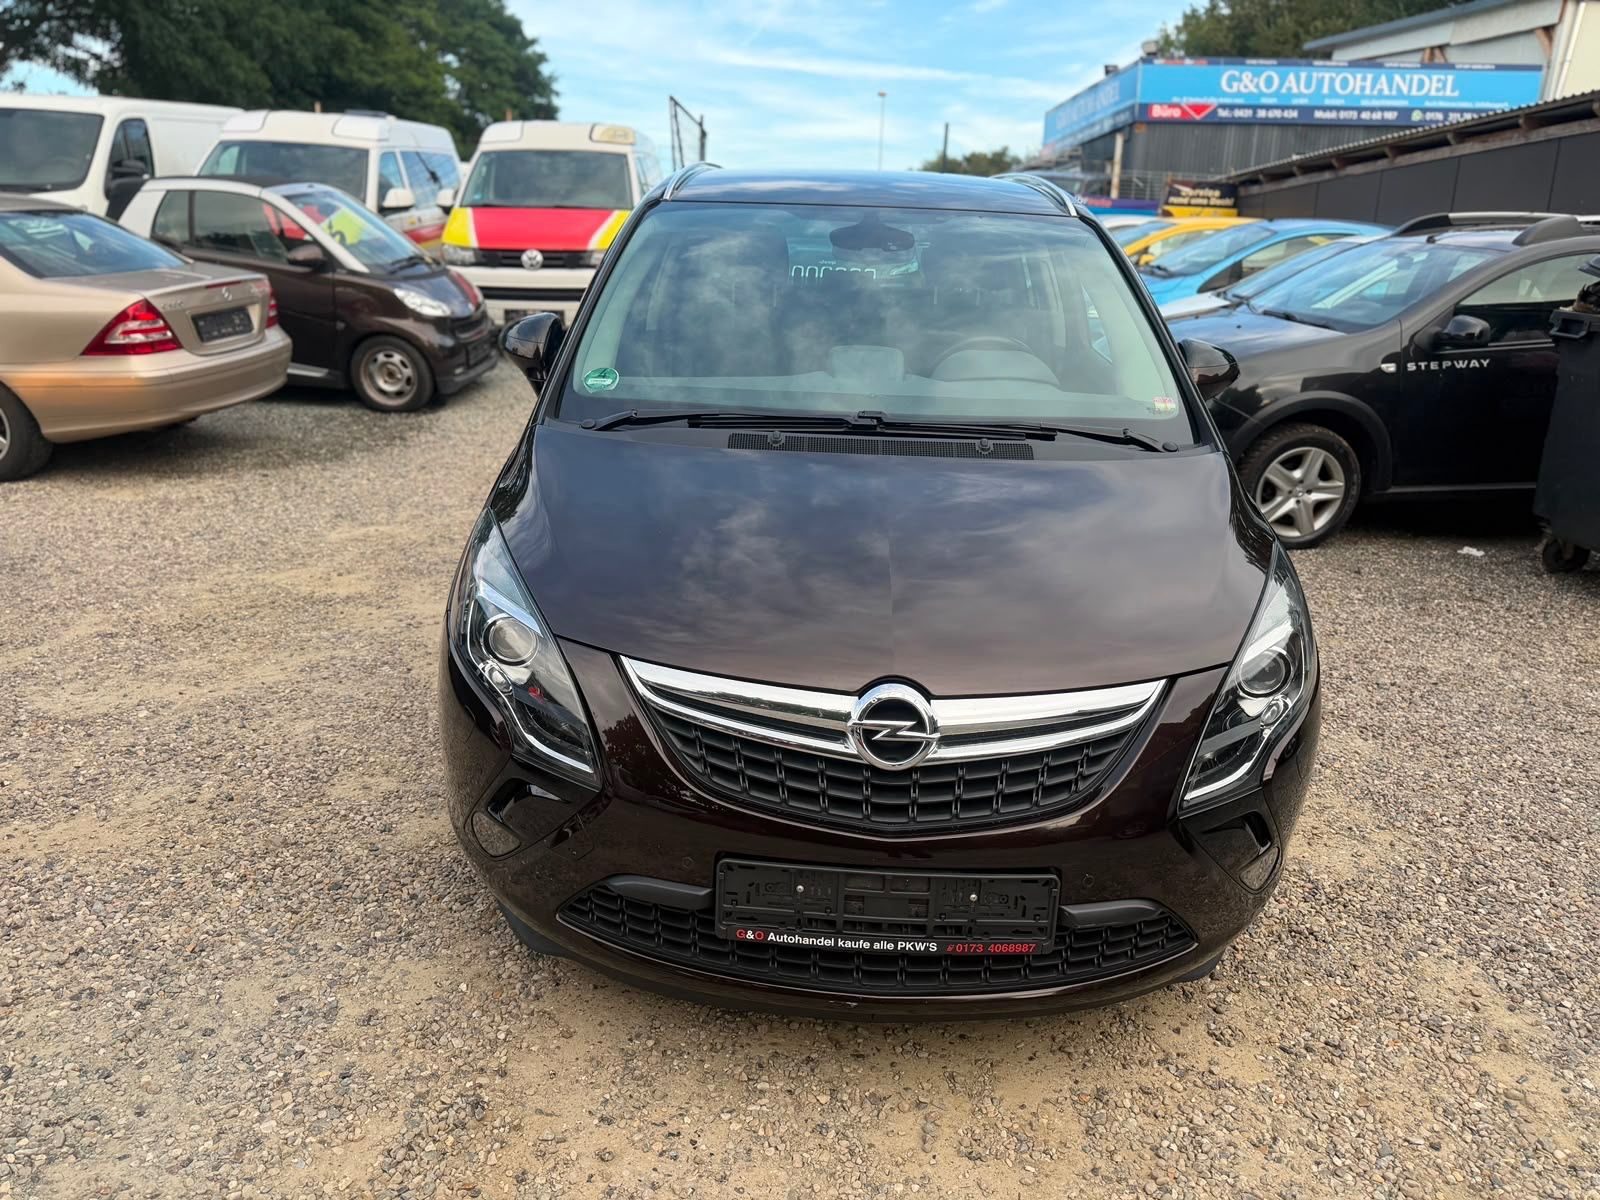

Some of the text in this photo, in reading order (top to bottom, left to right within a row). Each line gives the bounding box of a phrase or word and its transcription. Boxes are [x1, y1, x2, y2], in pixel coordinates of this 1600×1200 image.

[1221, 69, 1460, 97] G&O AUTOHANDEL
[1151, 104, 1182, 118] Büro
[1407, 358, 1491, 372] STEPWAY
[736, 928, 764, 941] G&O
[767, 932, 835, 947] Autohandel
[838, 938, 871, 949] kaufe
[873, 940, 894, 950] alle
[897, 940, 938, 952] PKW'S
[987, 943, 1036, 953] 4068987
